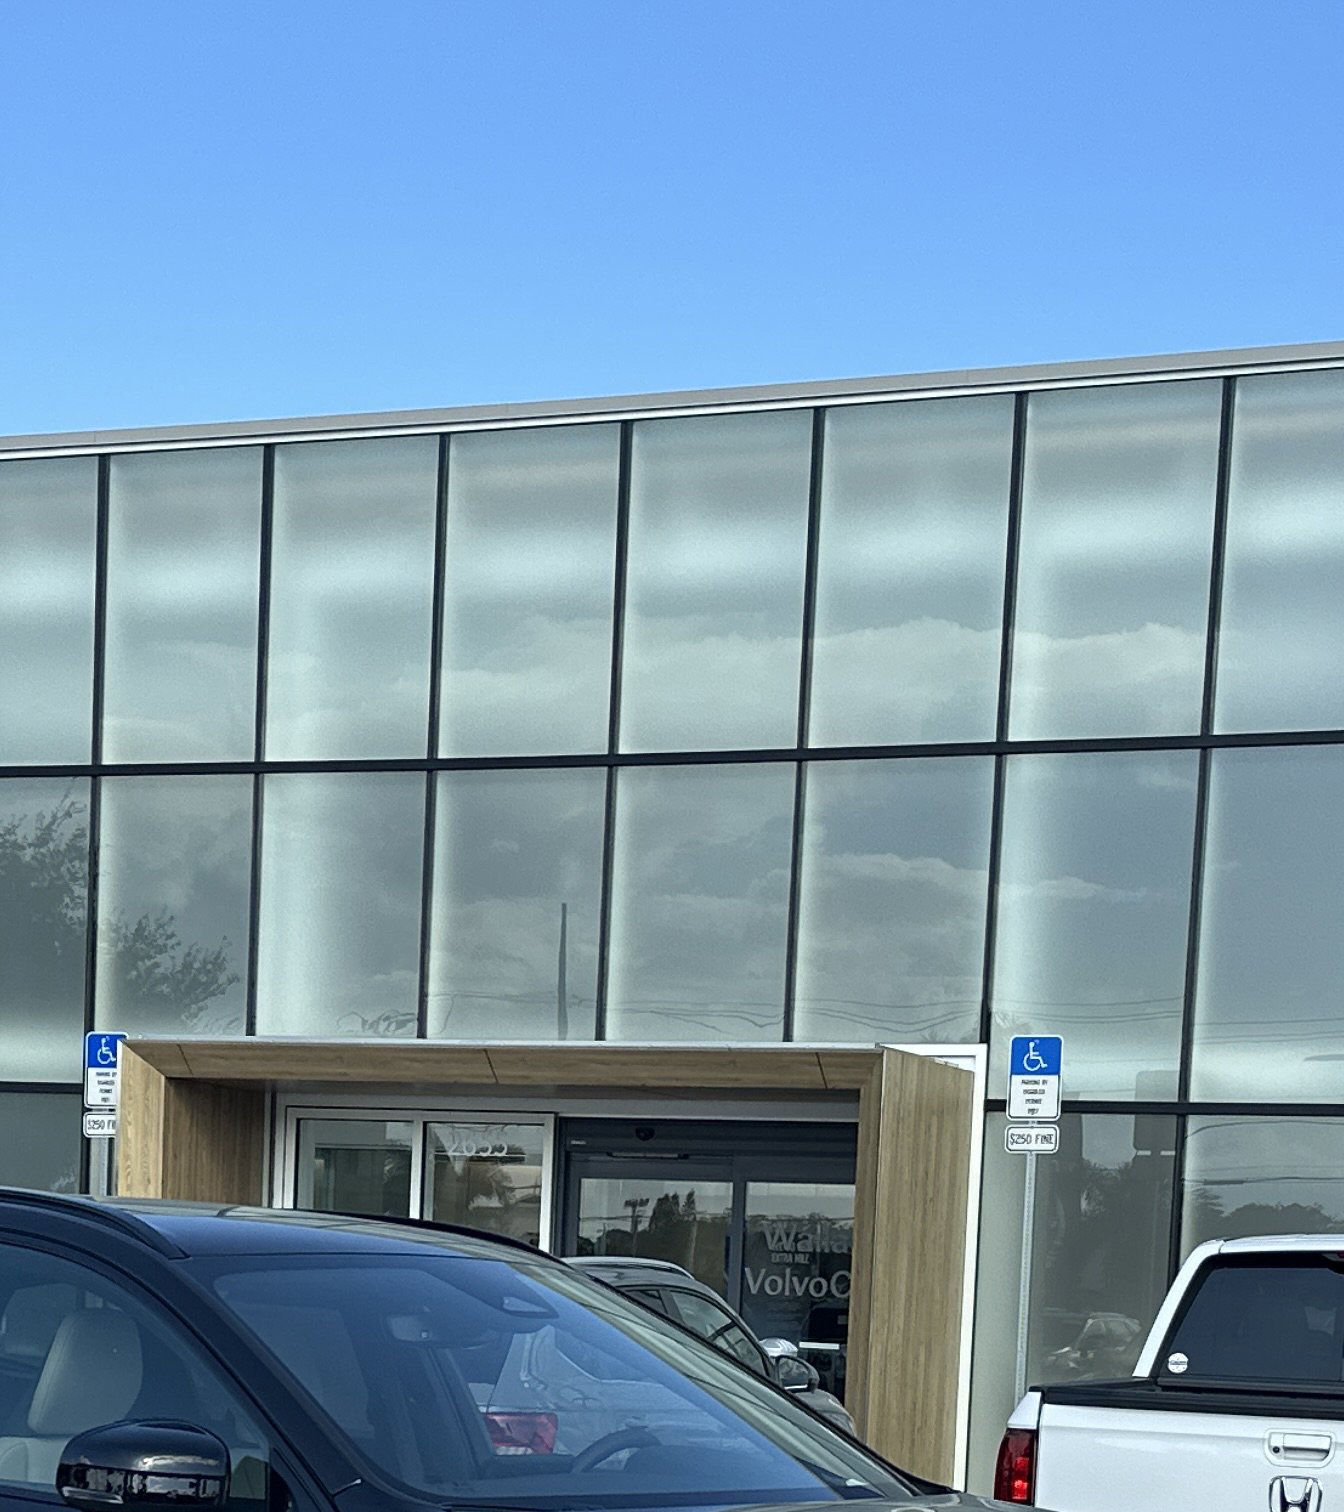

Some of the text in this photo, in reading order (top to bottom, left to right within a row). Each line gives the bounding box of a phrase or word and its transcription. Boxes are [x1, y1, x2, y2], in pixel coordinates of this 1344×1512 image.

[1009, 1132, 1033, 1146] $250
[760, 1220, 851, 1253] Walla
[744, 1267, 850, 1299] VolvoC
